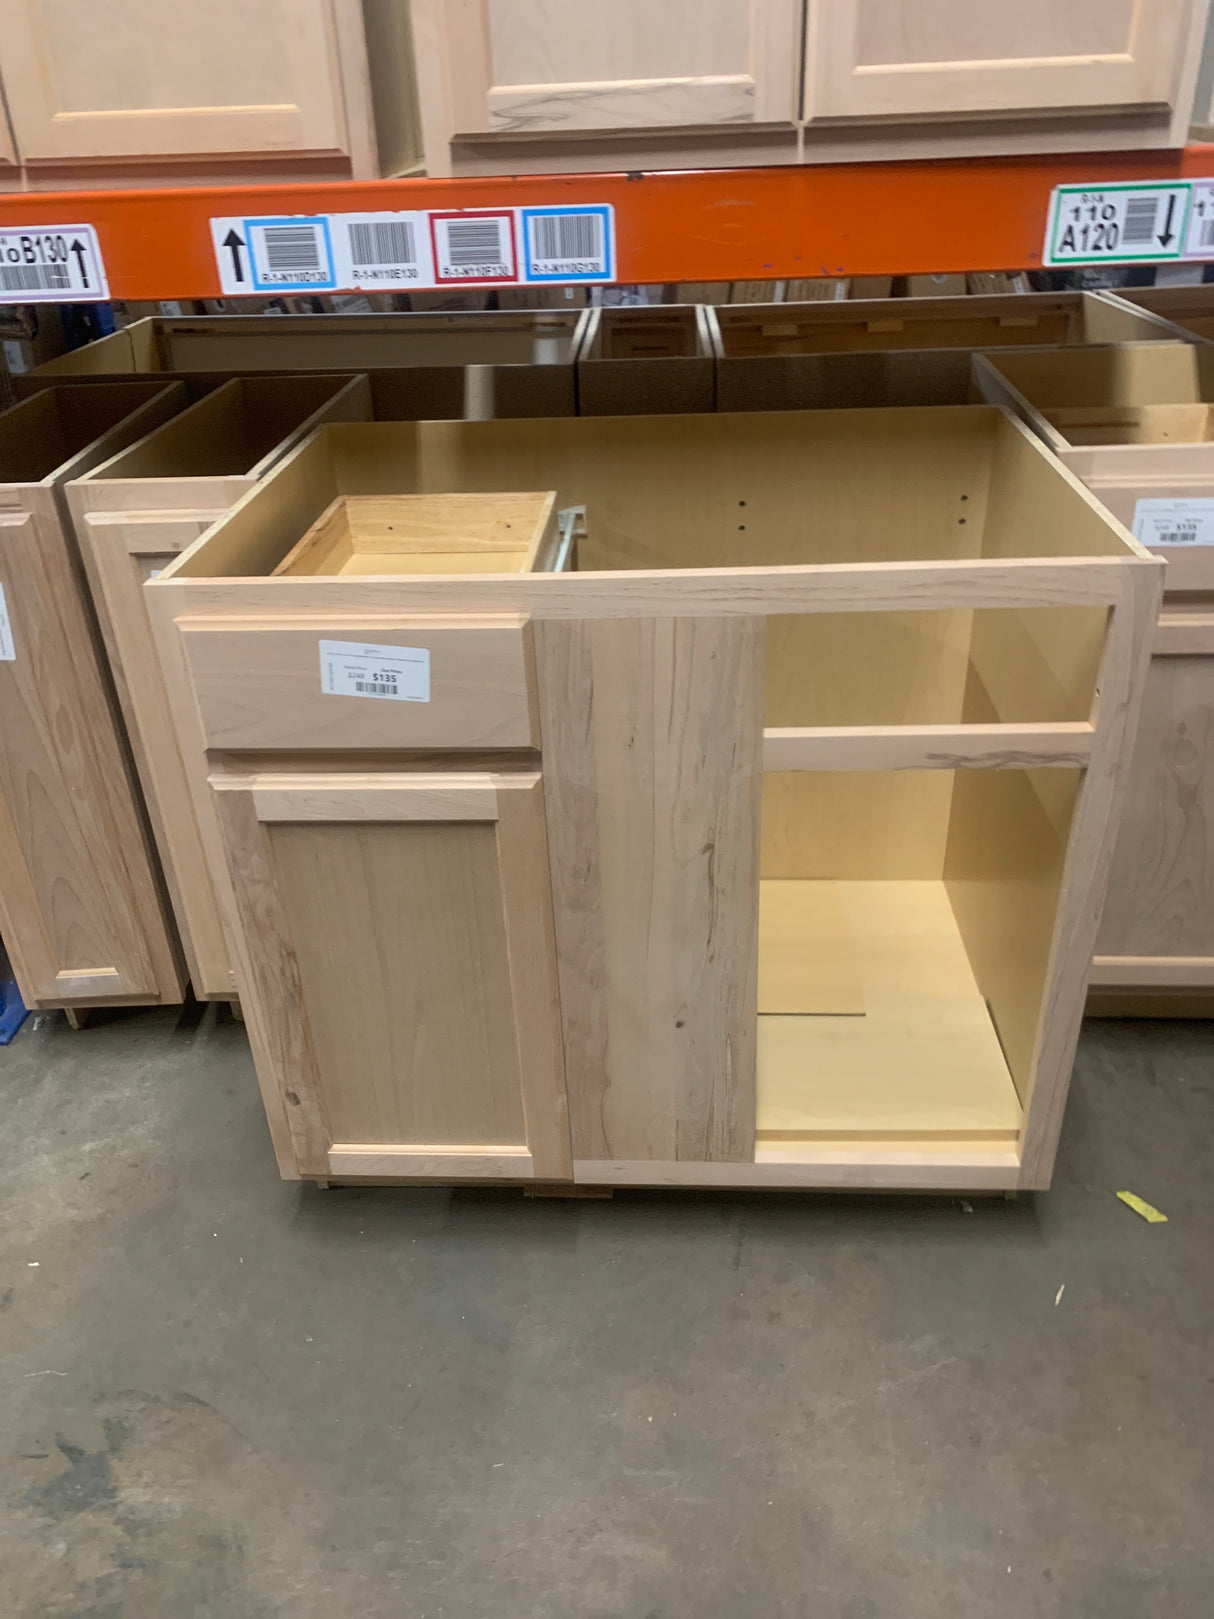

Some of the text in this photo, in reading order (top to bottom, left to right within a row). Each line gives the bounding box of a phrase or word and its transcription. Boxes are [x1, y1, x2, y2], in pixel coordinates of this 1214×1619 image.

[1069, 204, 1116, 222] 110
[1058, 222, 1119, 253] A120
[372, 673, 397, 683] $135
